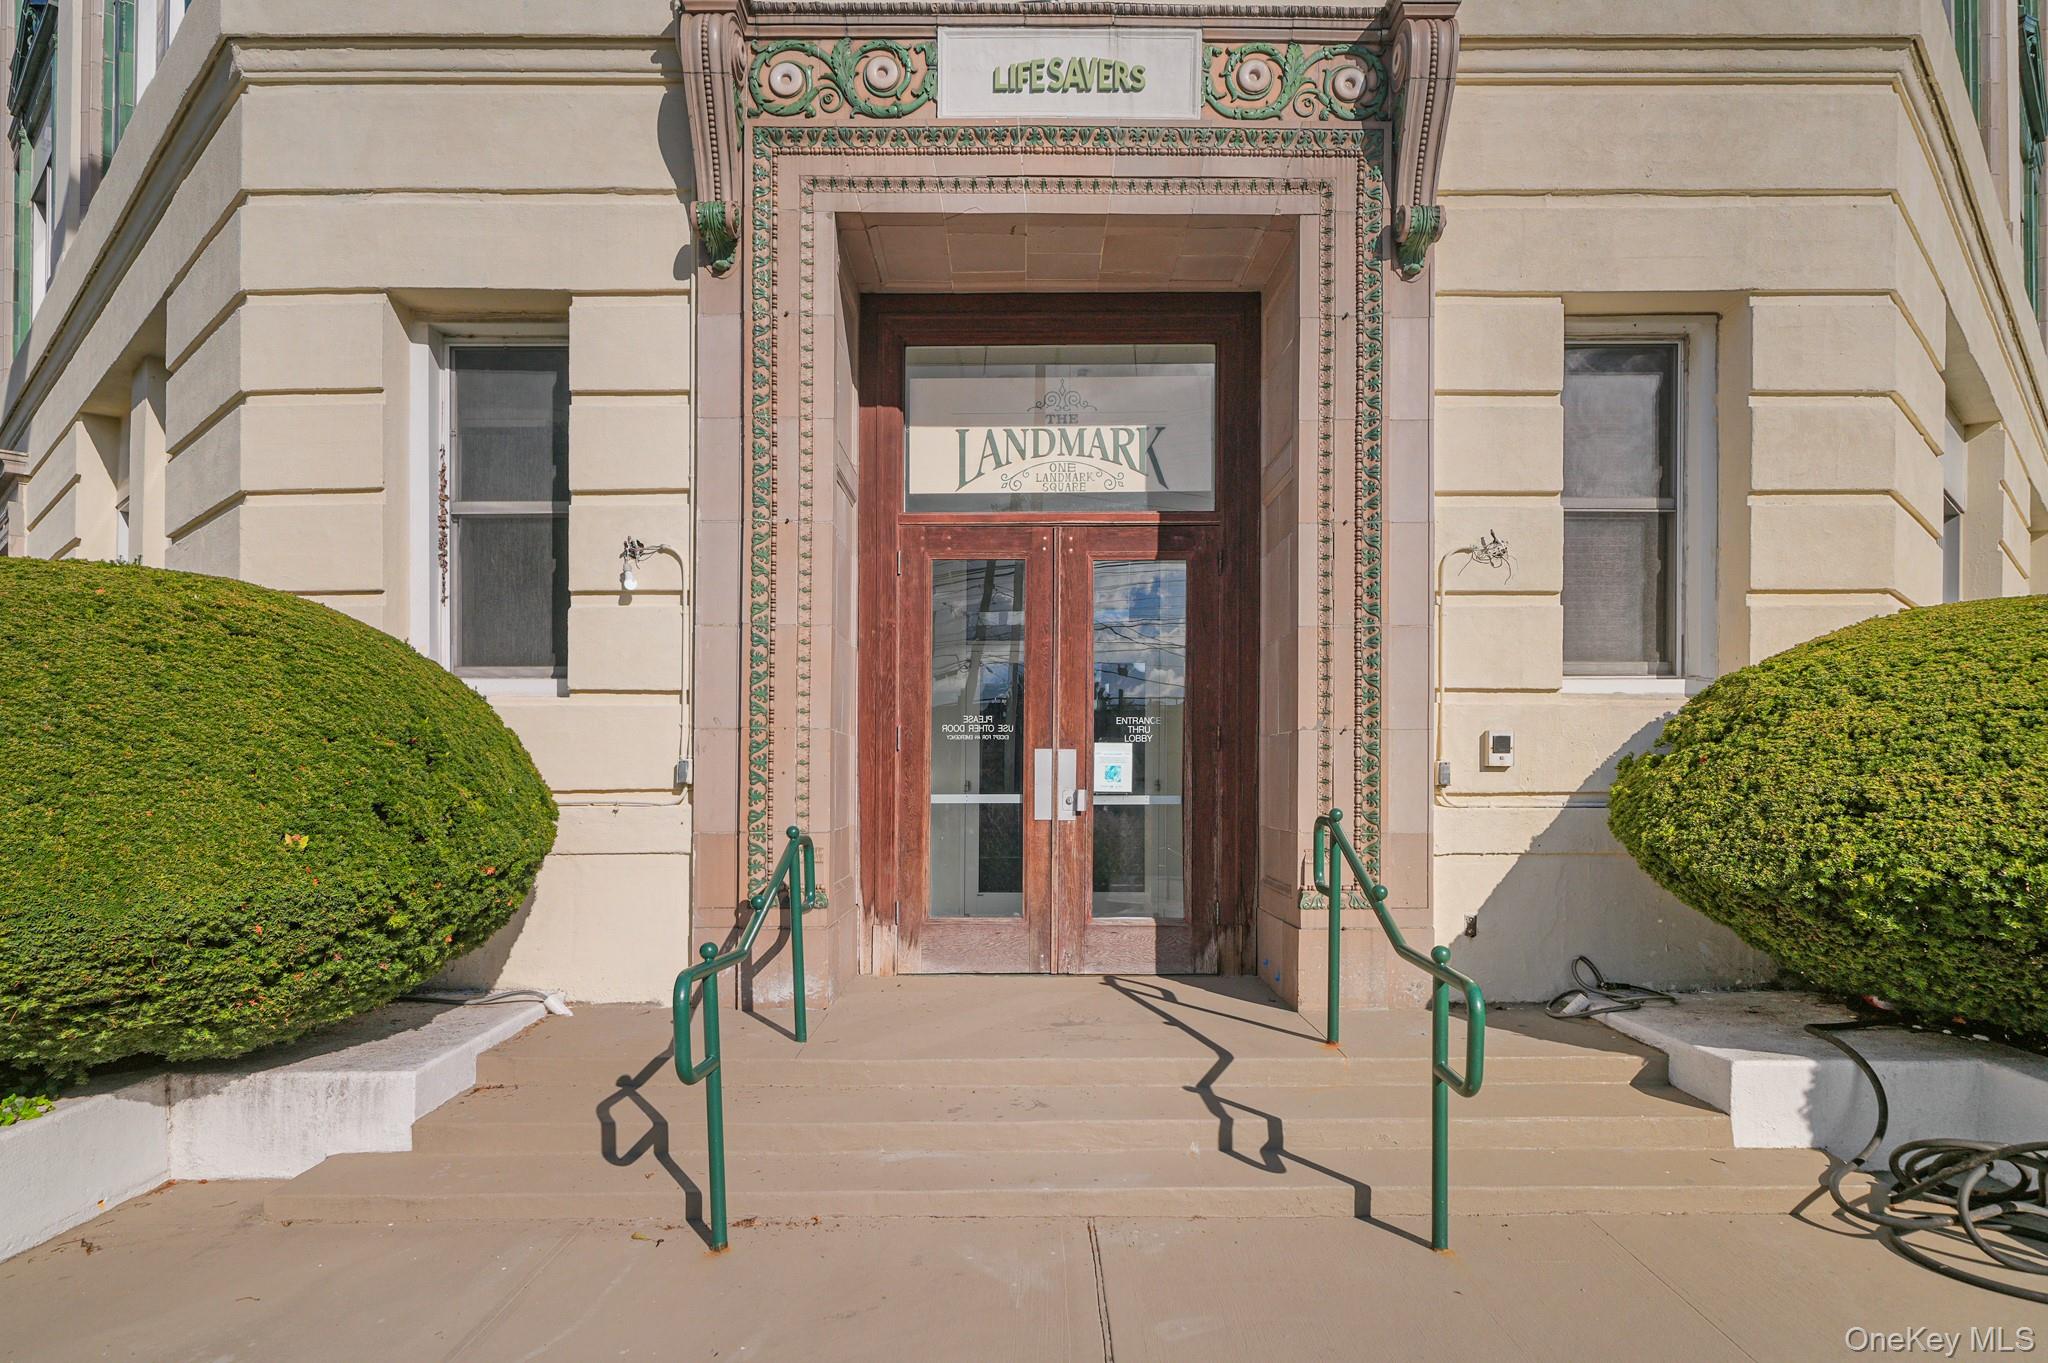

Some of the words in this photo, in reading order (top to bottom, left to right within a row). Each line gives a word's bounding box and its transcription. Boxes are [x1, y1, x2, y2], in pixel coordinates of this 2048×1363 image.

[1045, 414, 1079, 425] THE
[955, 426, 1169, 492] LANDMARK
[1049, 463, 1077, 473] ONE
[1035, 472, 1095, 482] LANDMARK
[1042, 482, 1087, 492] SQUARE
[1115, 716, 1161, 725] ENTRANCE
[1127, 725, 1151, 734] THRU
[1124, 734, 1153, 743] LOBBY
